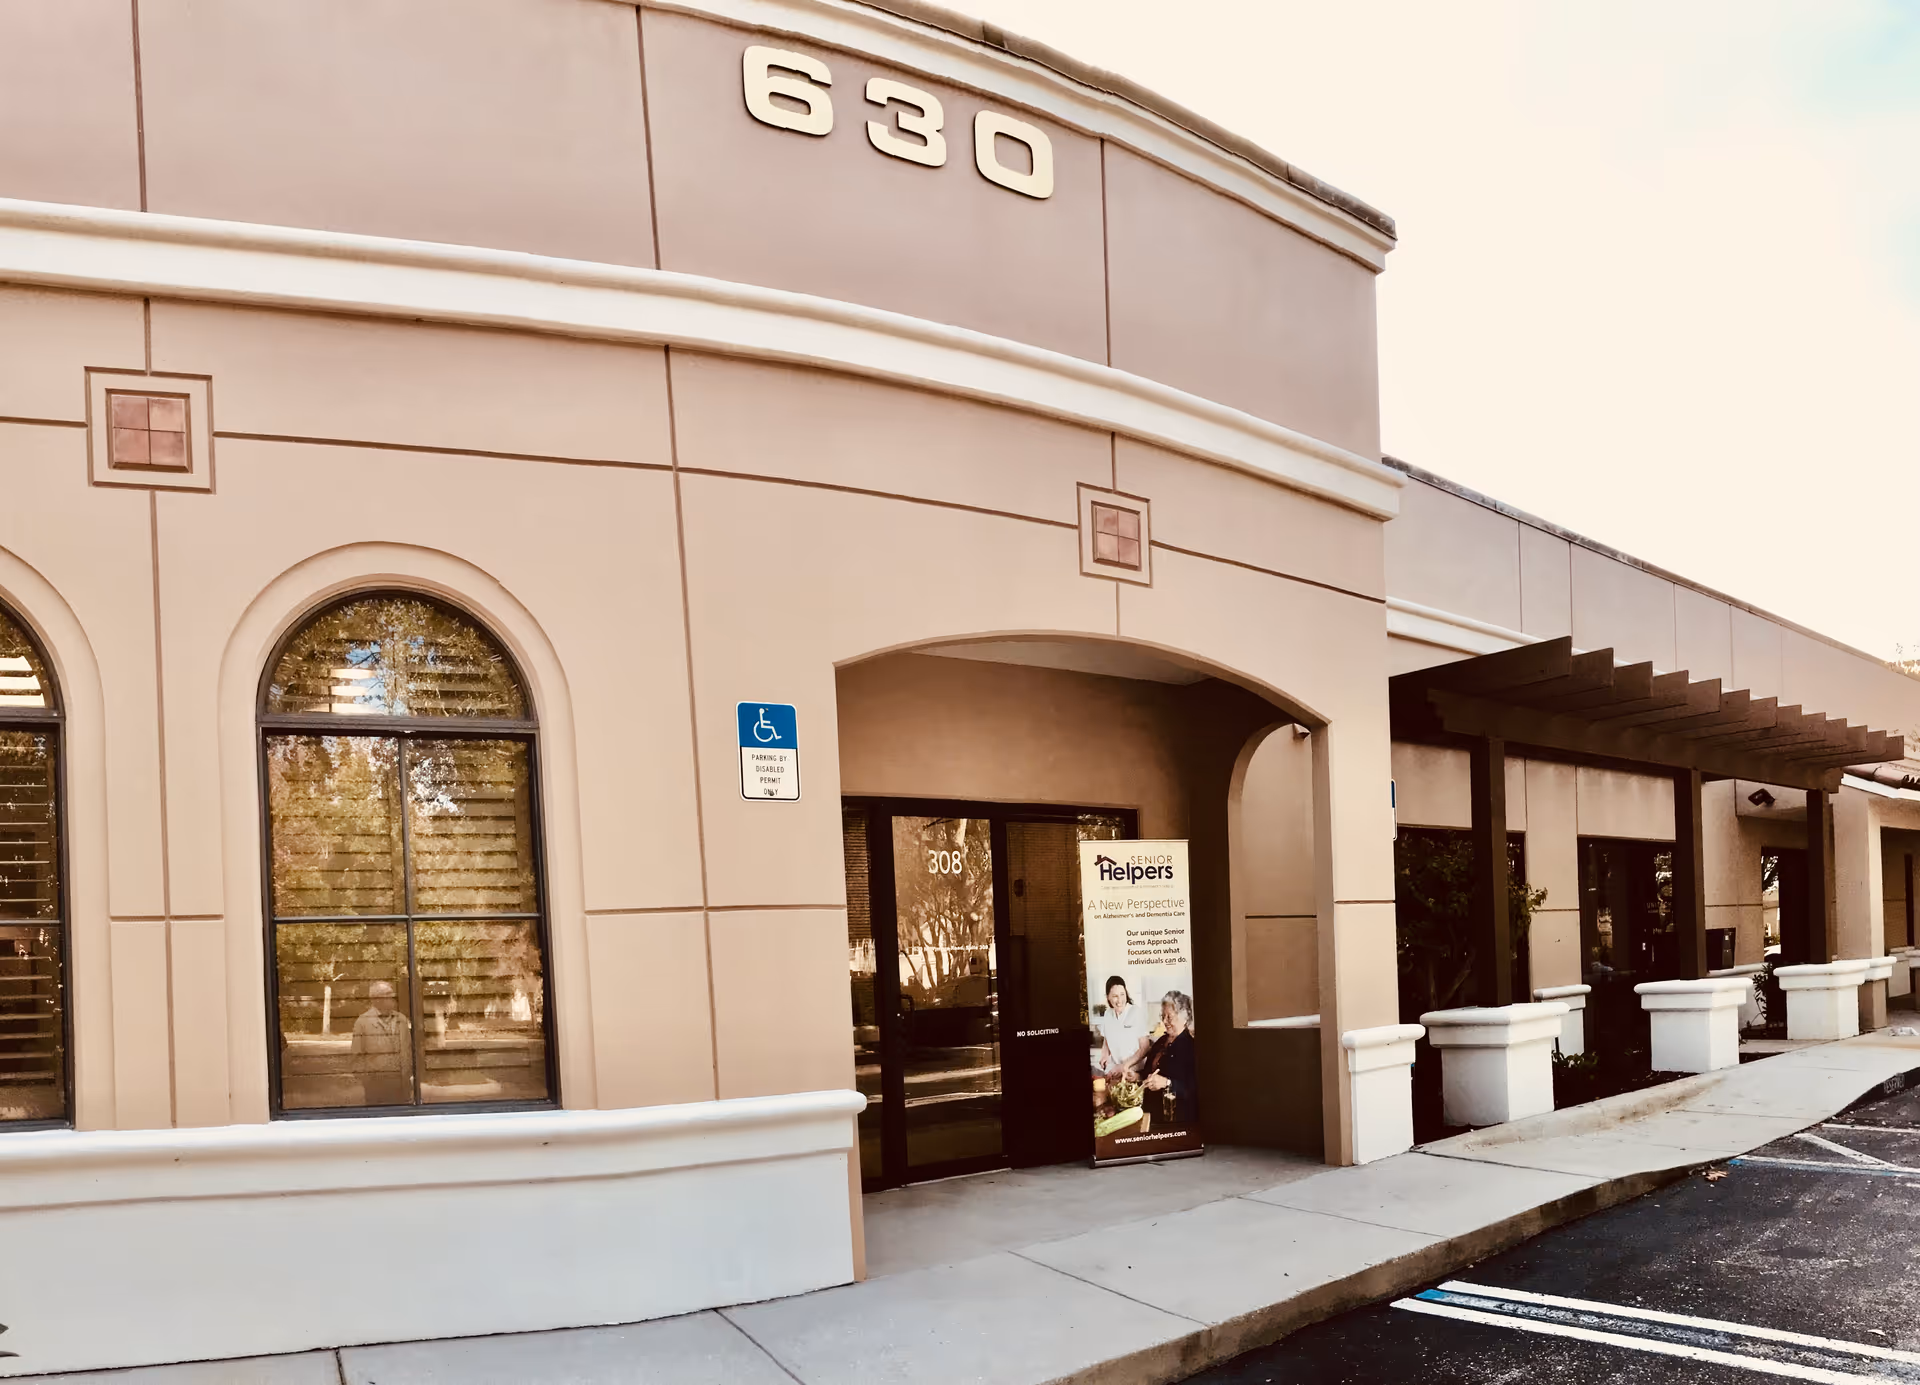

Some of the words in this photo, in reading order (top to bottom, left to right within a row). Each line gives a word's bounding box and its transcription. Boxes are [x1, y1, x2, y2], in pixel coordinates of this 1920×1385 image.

[743, 45, 1054, 199] 630
[755, 765, 784, 773] DISABLED
[759, 776, 780, 784] PERMIT
[928, 849, 962, 874] 308
[1130, 855, 1173, 865] SENIOR
[1099, 862, 1174, 885] Helpers
[1087, 900, 1096, 910] A
[1100, 900, 1124, 910] New
[1127, 898, 1185, 910] Perspective
[1147, 938, 1178, 946] Approach
[1027, 1028, 1059, 1036] SOLICITING
[1114, 1130, 1187, 1144] www.seniorhelpers.com
